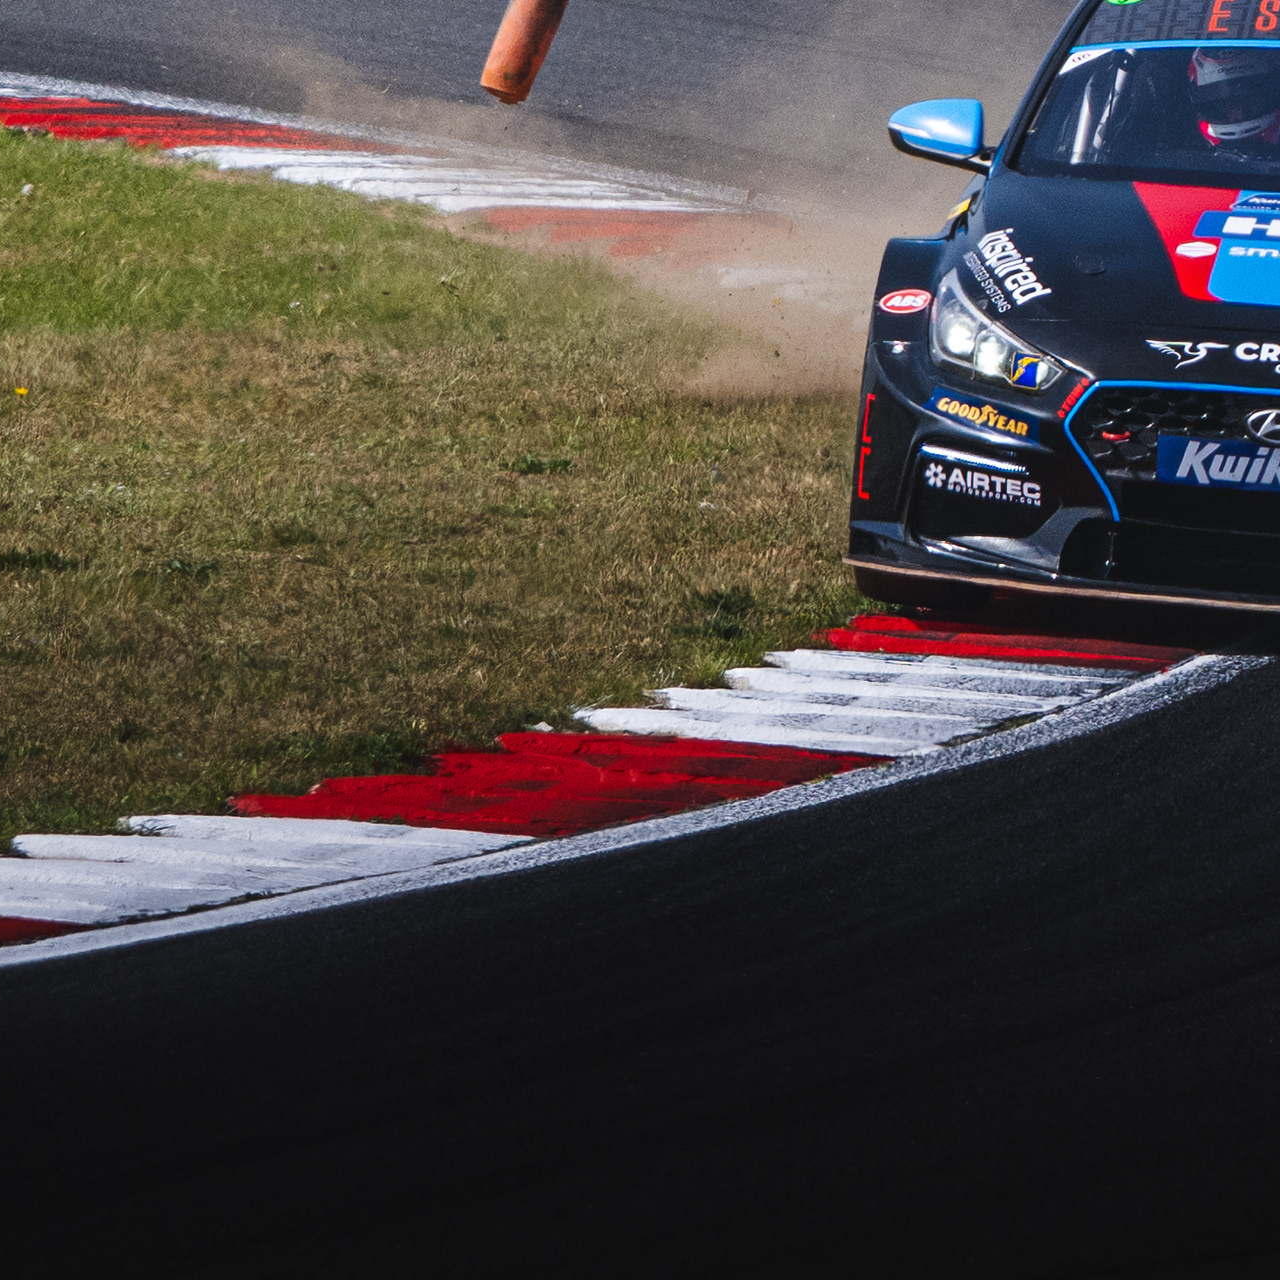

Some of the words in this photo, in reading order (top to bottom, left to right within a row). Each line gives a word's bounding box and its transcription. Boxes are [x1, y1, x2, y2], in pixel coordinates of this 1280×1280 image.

[977, 228, 1052, 305] inspired
[886, 295, 928, 308] ABS
[936, 397, 1029, 436] GOODYEAR
[948, 468, 1041, 499] AIRTEC
